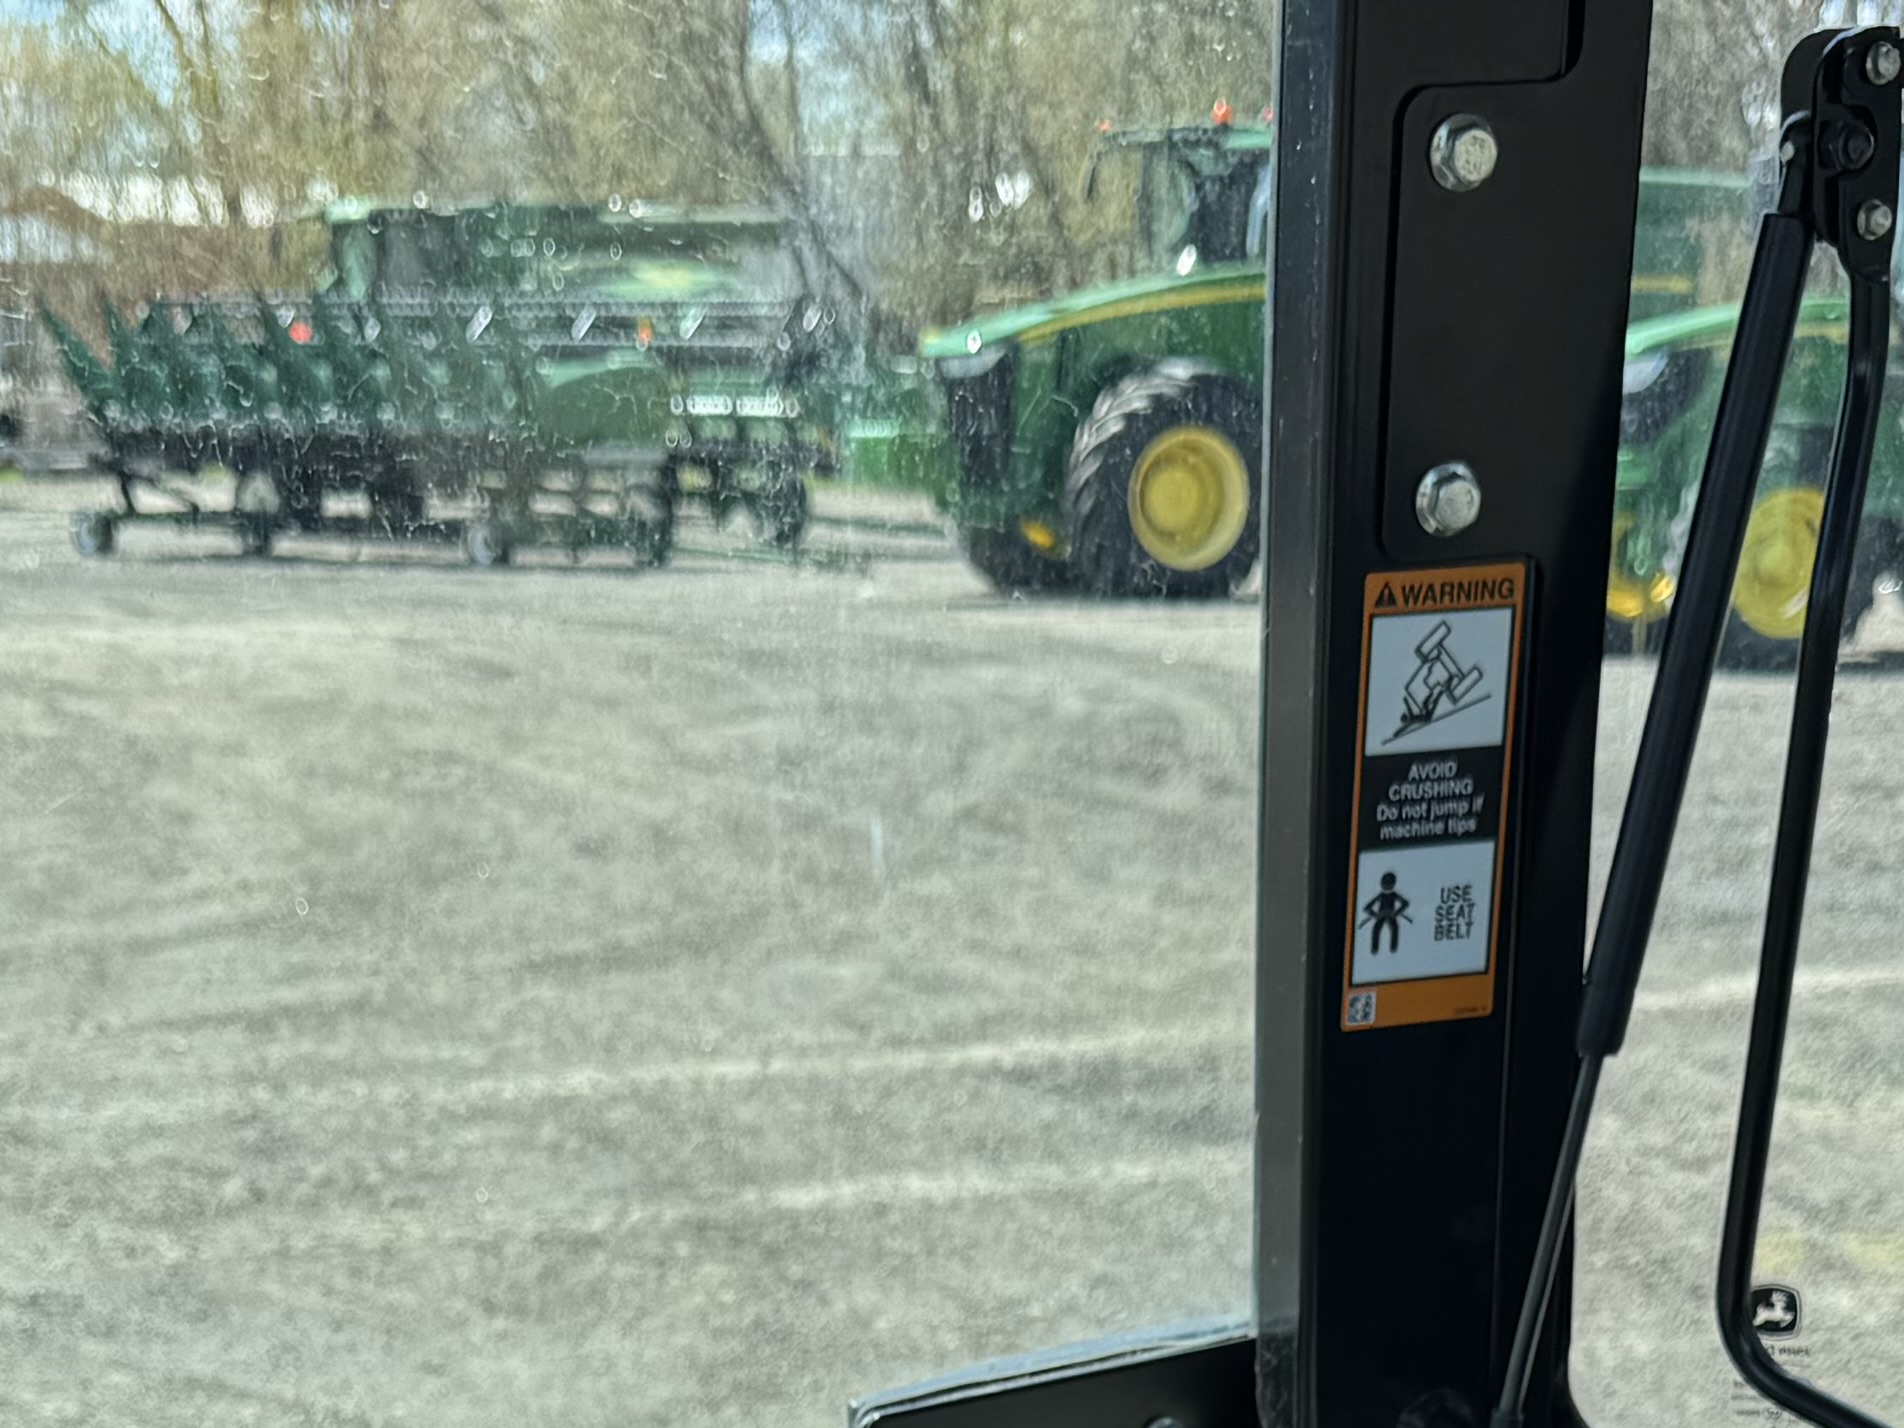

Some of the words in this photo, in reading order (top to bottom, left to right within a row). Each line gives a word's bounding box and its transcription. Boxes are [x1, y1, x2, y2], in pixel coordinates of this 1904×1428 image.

[1401, 577, 1514, 606] WARNING
[1408, 761, 1457, 781] AVOID
[1388, 777, 1474, 801] CRUSHING
[1376, 804, 1399, 822] Do
[1401, 801, 1428, 820] not
[1429, 798, 1470, 820] jump
[1379, 820, 1446, 840] machine
[1447, 817, 1477, 836] tips
[1440, 884, 1473, 904] USE
[1435, 902, 1475, 922] SEAT
[1434, 921, 1474, 941] BELT
